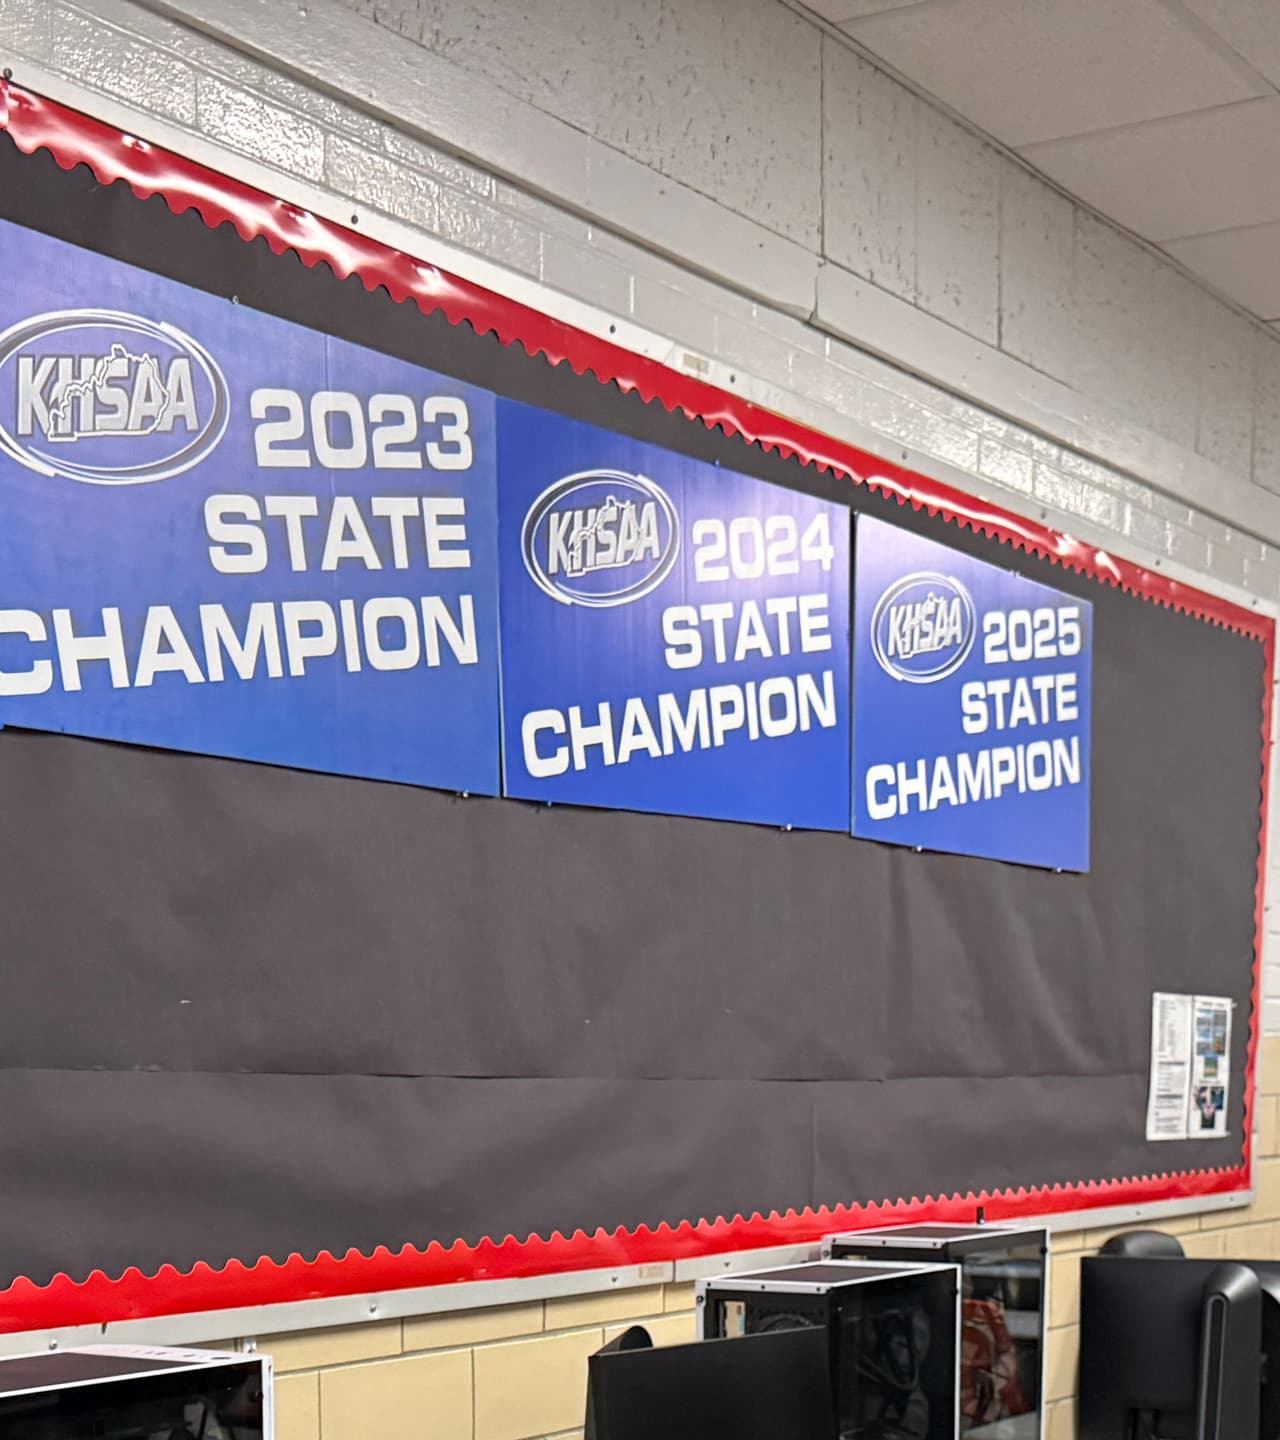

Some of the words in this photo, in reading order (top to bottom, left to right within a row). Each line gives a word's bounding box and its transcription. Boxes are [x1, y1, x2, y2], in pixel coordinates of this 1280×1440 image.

[17, 354, 199, 436] KHSAA
[250, 388, 473, 470] 2023
[204, 494, 471, 573] STATE
[548, 502, 660, 576] KHSAA
[692, 513, 834, 582] 2024
[662, 594, 832, 669] STATE
[887, 597, 962, 657] KHSAA
[983, 606, 1082, 664] 2025
[521, 671, 837, 778] CHAMPION
[961, 673, 1079, 734] STATE
[865, 736, 1081, 820] CHAMPION
